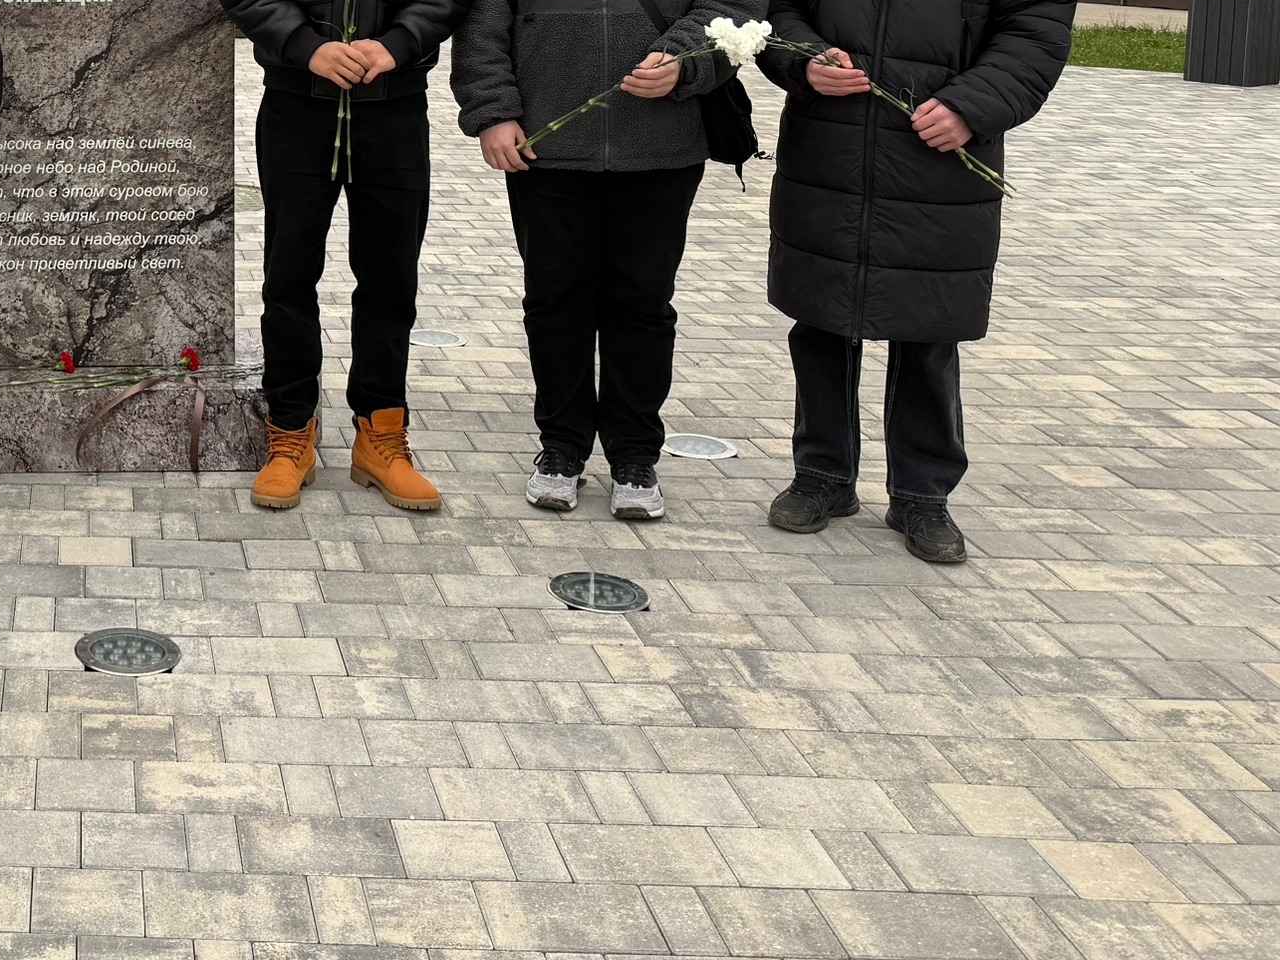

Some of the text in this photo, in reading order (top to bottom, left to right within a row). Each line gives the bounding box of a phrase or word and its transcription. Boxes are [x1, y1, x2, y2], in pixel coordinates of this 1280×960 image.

[46, 136, 74, 150] над
[78, 136, 135, 150] землёй
[139, 138, 196, 151] синева,
[36, 160, 74, 174] небо
[78, 160, 106, 174] над
[110, 160, 180, 176] Родиной,
[13, 187, 44, 198] что
[49, 187, 58, 198] в
[61, 186, 105, 198] этом
[109, 186, 173, 200] суровом
[177, 183, 209, 197] бою
[42, 211, 100, 224] земляк,
[105, 207, 147, 221] твой
[151, 207, 195, 221] сосед
[6, 232, 66, 246] любовь
[70, 235, 80, 246] и
[84, 231, 151, 249] надежду
[154, 234, 202, 245] твою.
[29, 256, 136, 273] приветливый
[141, 258, 184, 269] свет.
